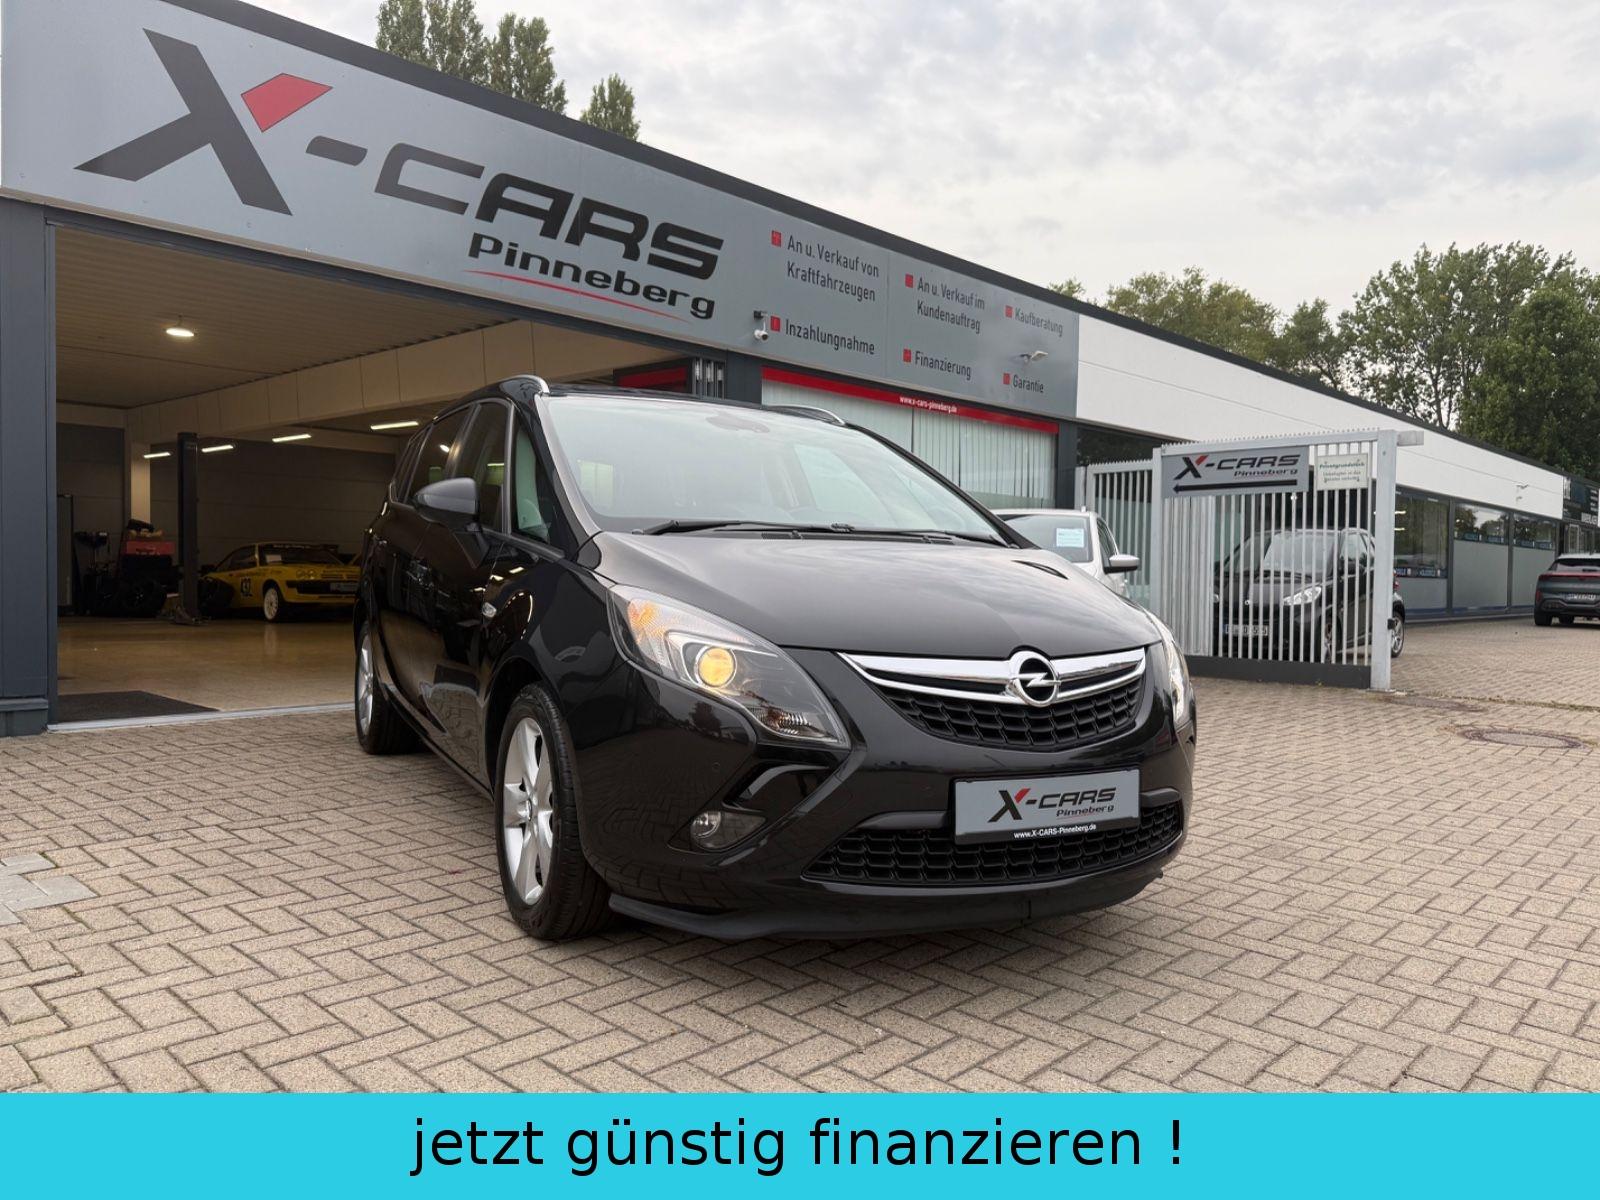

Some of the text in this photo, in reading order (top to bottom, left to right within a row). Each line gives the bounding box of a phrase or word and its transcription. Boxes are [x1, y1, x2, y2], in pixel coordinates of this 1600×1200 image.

[73, 27, 724, 281] X-CARS
[787, 235, 879, 278] An u. Verkauf von
[468, 232, 715, 320] Pinneberg
[787, 260, 876, 302] Kraftfahrzeugen
[917, 276, 985, 310] An u. Verkauf im
[917, 300, 980, 334] Kundenauftrag
[1014, 307, 1063, 337] Kaufberatung
[785, 319, 875, 355] Inzahlungnahme
[914, 351, 972, 380] Finanzierung
[1013, 374, 1044, 394] Garantie
[1173, 454, 1301, 480] X-CARS
[1234, 468, 1298, 477] Pinneberg
[987, 787, 1117, 823] X-CARS
[1056, 803, 1115, 817] Pinneberg
[1013, 823, 1097, 839] www.X-CARS-Pinneberg.de
